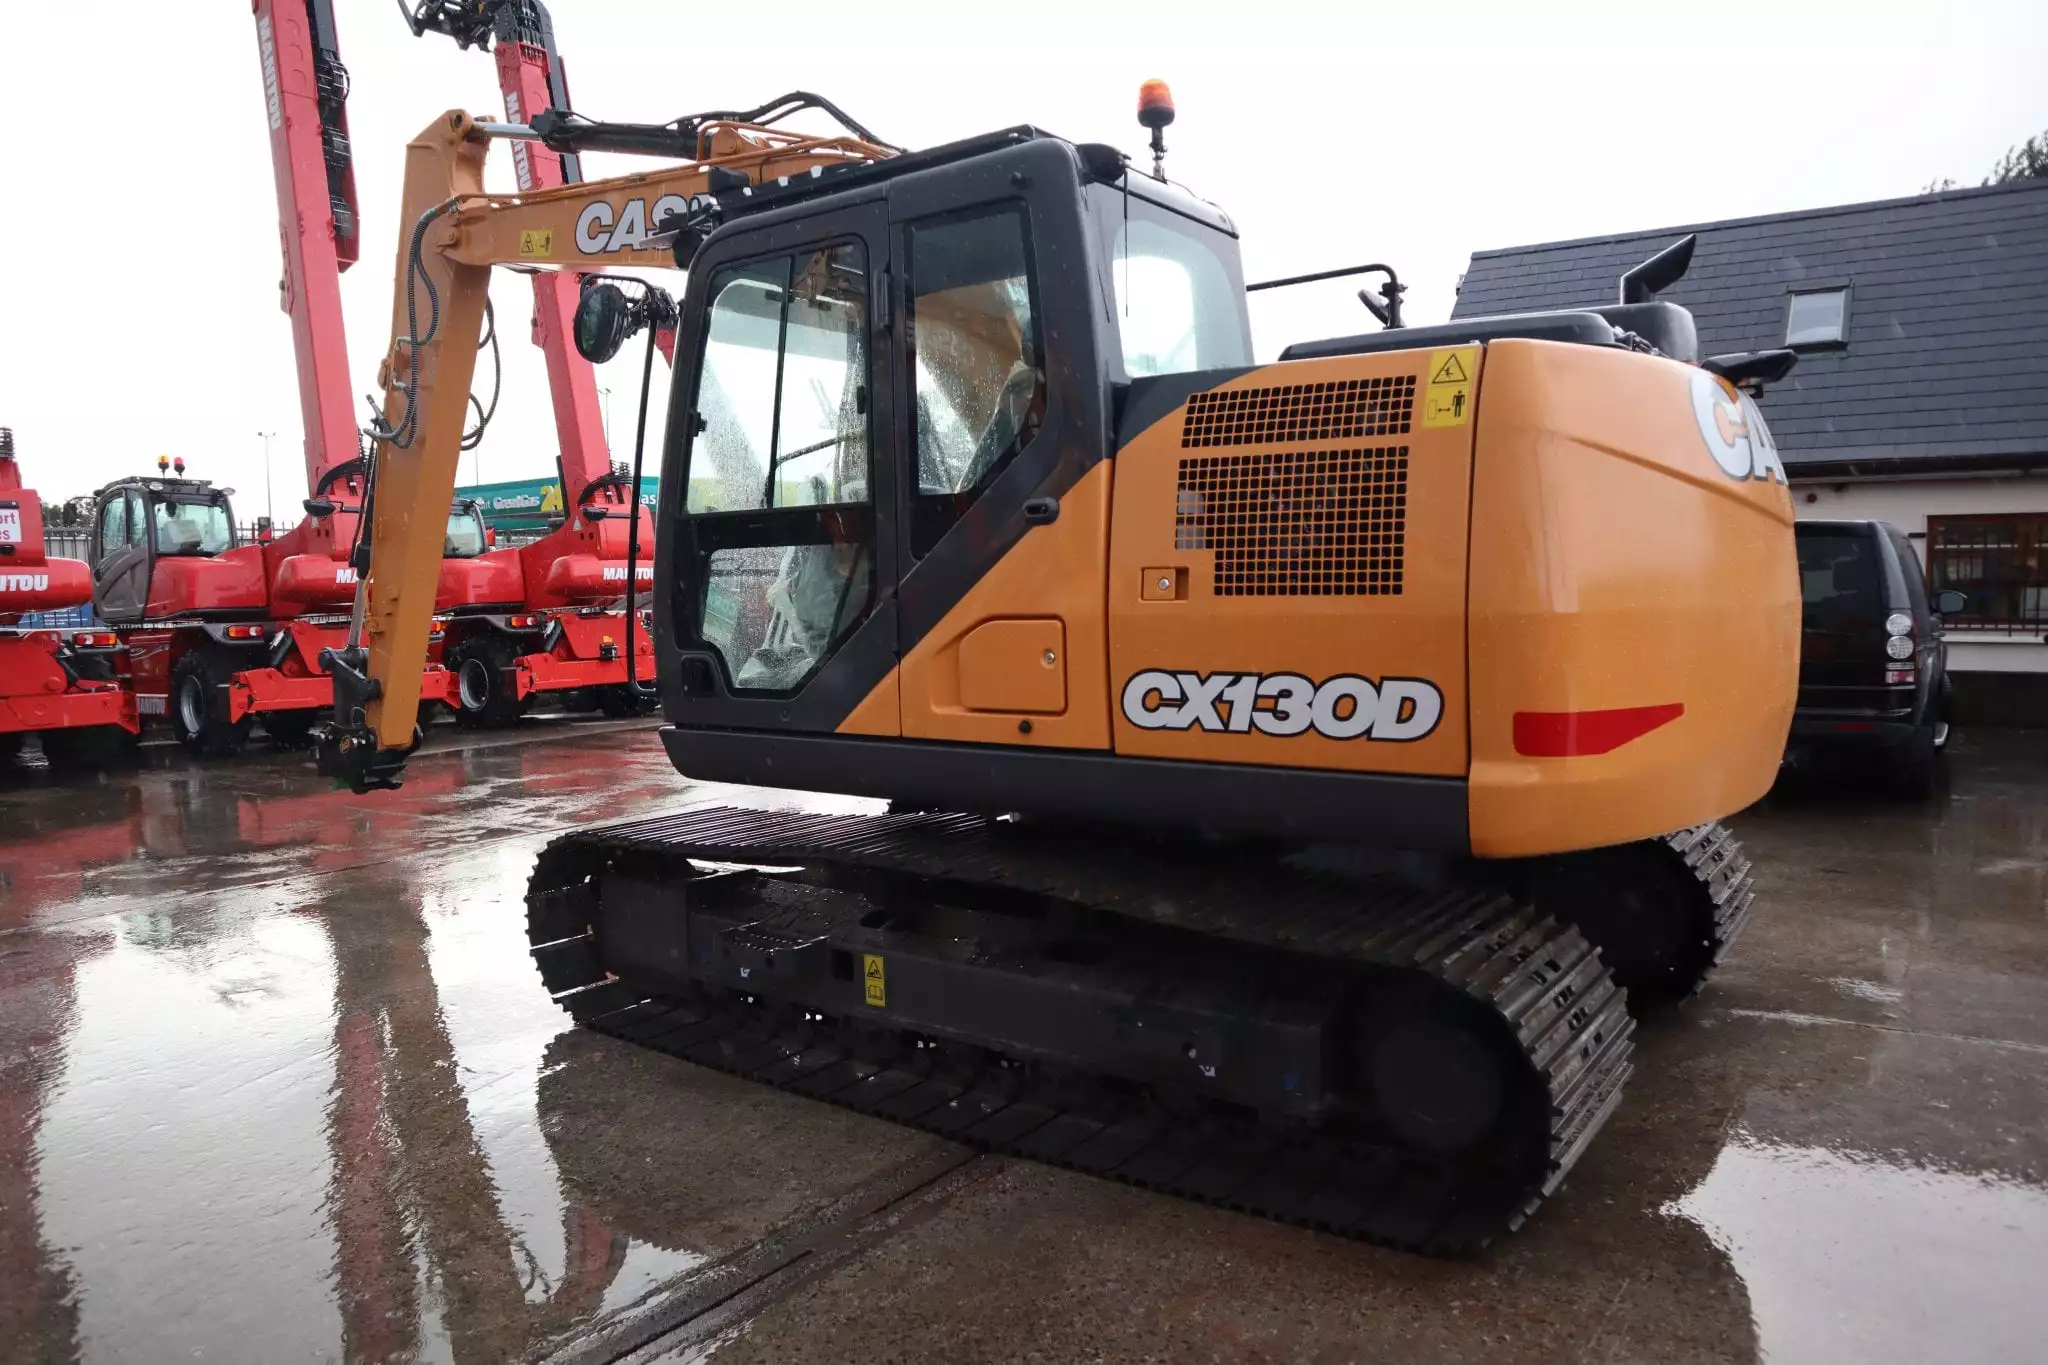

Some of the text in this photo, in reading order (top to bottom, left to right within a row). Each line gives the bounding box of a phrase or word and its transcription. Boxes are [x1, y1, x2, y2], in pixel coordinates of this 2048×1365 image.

[259, 16, 281, 131] MANITOU
[506, 91, 532, 190] MAITOU
[1121, 668, 1445, 743] CX130D
